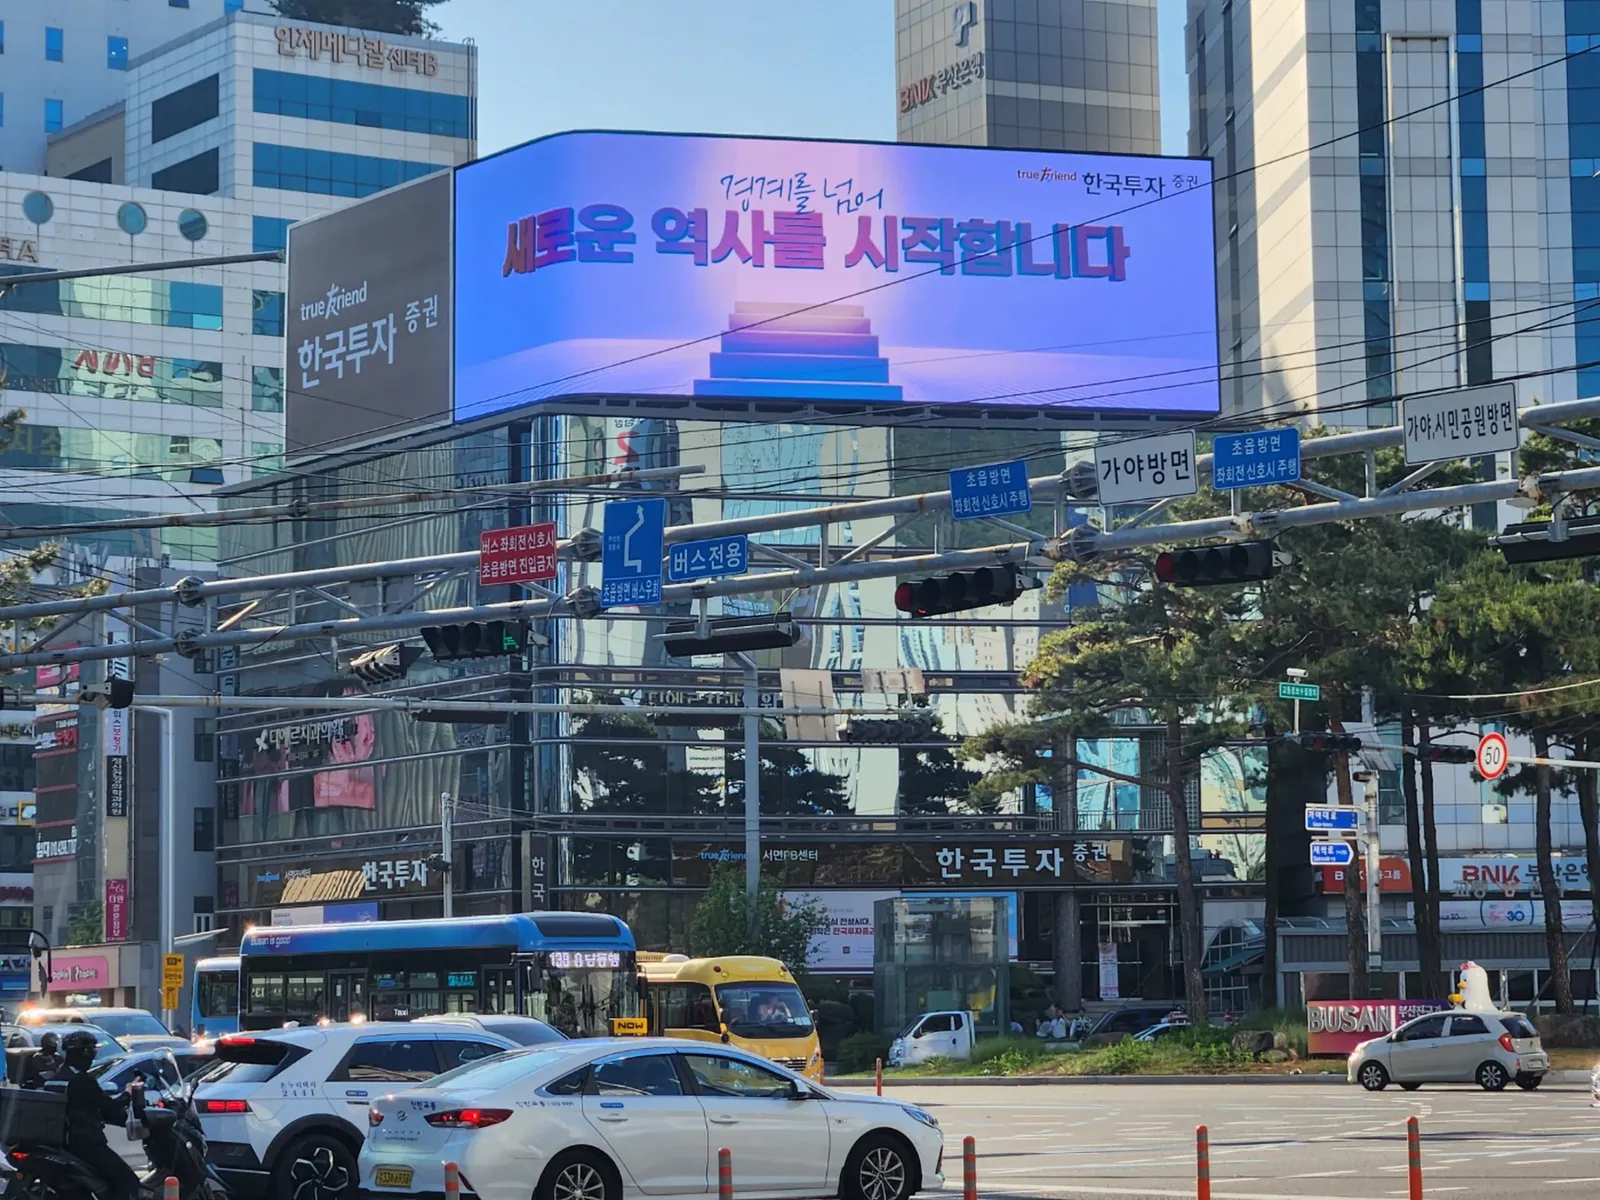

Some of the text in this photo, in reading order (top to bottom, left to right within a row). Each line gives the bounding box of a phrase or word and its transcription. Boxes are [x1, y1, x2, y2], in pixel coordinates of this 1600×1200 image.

[898, 52, 985, 115] BNK 부산은행
[720, 171, 884, 215] 경계를 넘어
[1082, 171, 1199, 198] 한국투자 증권
[502, 204, 1132, 282] 새로운 역사를 시작합니다
[298, 294, 438, 389] 한국투자 증권
[1231, 434, 1281, 456] 초읍방면
[966, 466, 1012, 488] 초읍방면
[1101, 447, 1192, 486] 가야방면
[481, 553, 555, 578] 초읍방면 진입금지
[674, 541, 743, 574] 버스전용
[1484, 746, 1501, 765] 50
[361, 859, 428, 891] 한국투자
[936, 843, 1108, 879] 한국투자 증권
[1462, 864, 1521, 883] BNK
[531, 856, 546, 906] 한국
[393, 1008, 409, 1016] Taxi
[617, 1022, 644, 1030] NOW
[1308, 1004, 1397, 1033] BUSAN
